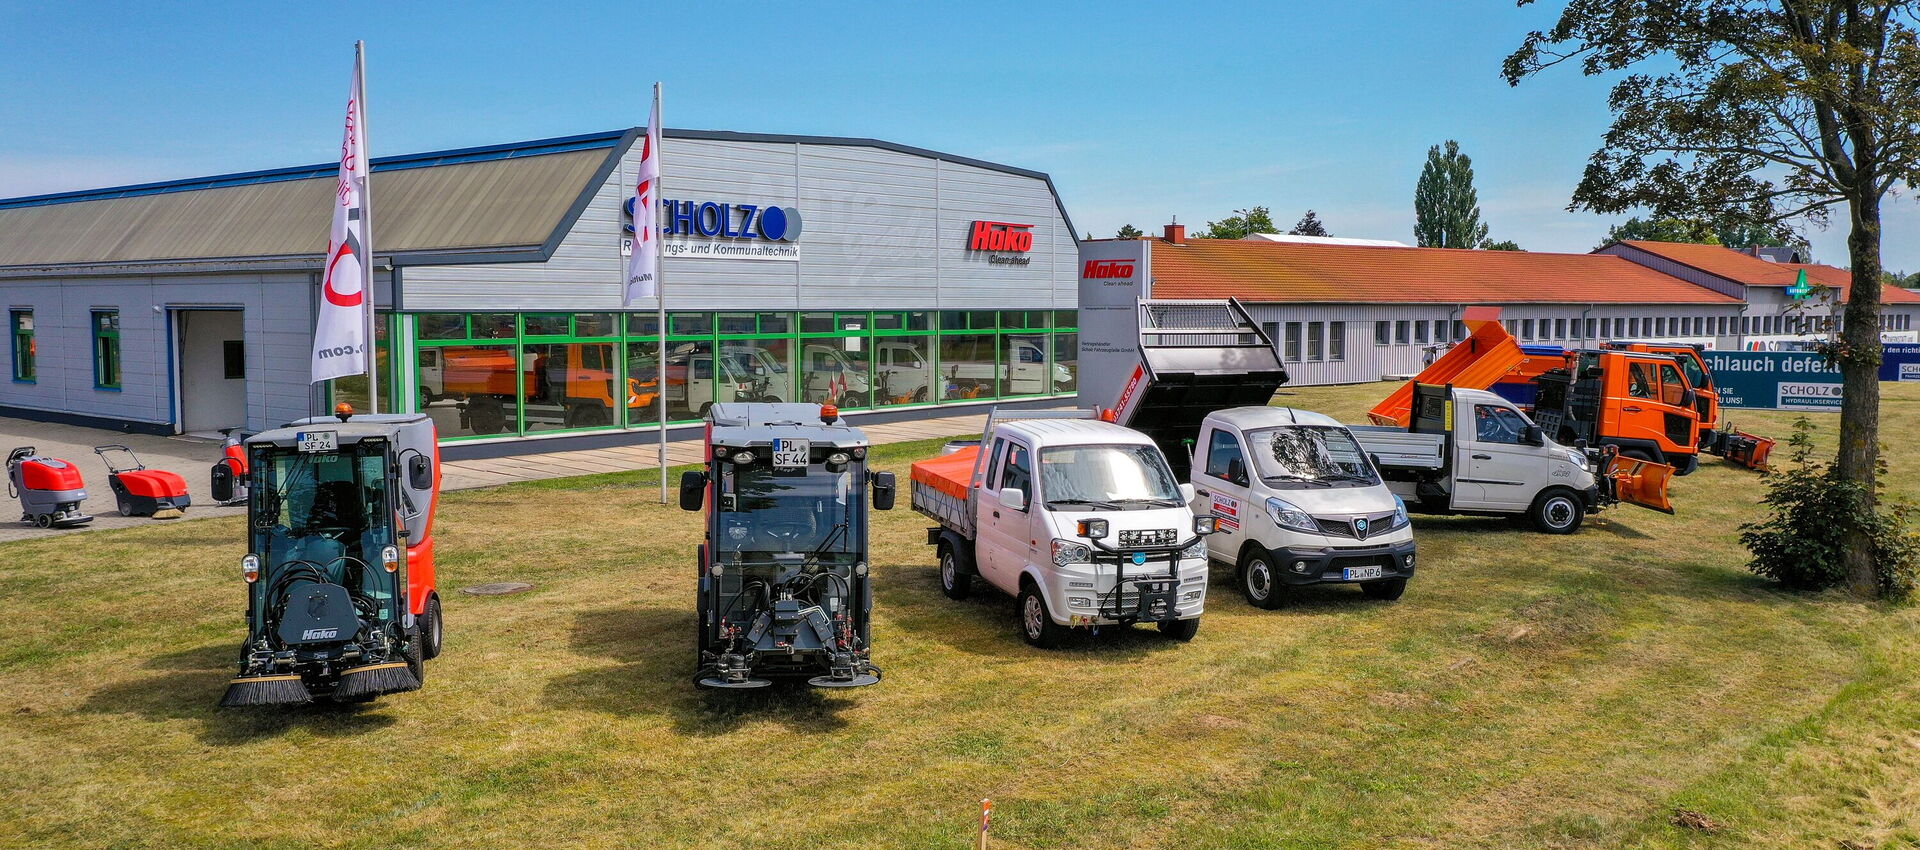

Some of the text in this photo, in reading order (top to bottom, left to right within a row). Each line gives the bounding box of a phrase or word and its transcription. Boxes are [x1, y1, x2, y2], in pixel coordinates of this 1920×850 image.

[971, 221, 1035, 252] Hako
[691, 243, 710, 254] und
[713, 244, 798, 257] Kommunaltechnik
[988, 254, 1031, 265] Clean ahead
[1083, 259, 1136, 279] Hako
[1705, 355, 1775, 372] chlauch
[1901, 365, 1920, 373] SCH
[1722, 387, 1734, 395] SIE
[1781, 385, 1830, 396] SCHOLZ
[306, 433, 319, 441] PL
[304, 441, 331, 450] SF 24
[782, 440, 797, 452] PL
[774, 452, 807, 465] SF 44
[1213, 495, 1231, 507] SCHOLZ
[1350, 568, 1381, 578] PL NP 6
[302, 627, 339, 641] Hako
